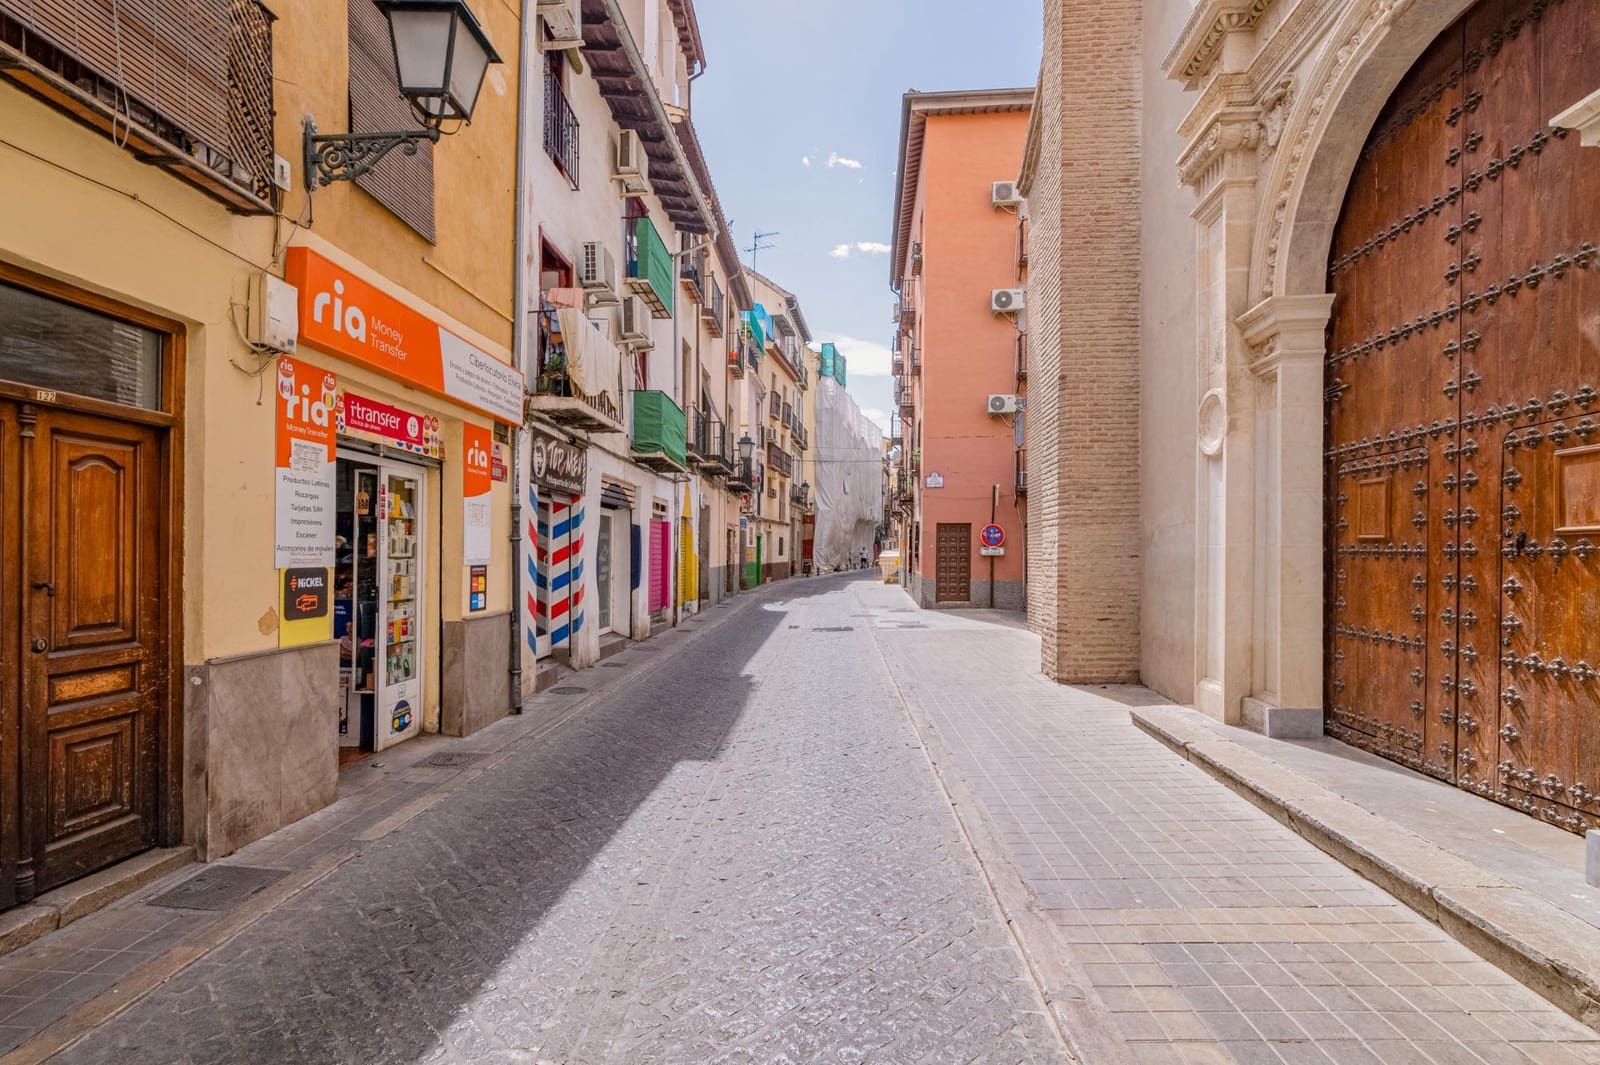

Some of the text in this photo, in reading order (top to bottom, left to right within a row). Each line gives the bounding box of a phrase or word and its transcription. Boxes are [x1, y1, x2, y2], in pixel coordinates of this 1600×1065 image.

[314, 280, 366, 343] ria
[371, 316, 403, 346] Money
[371, 333, 407, 360] Transfer
[39, 391, 55, 401] 122
[286, 384, 329, 427] ria
[286, 423, 307, 435] Money
[467, 440, 488, 468] ria
[282, 475, 330, 489] Productos Latinos
[295, 490, 319, 500] Recargas
[290, 504, 312, 513] Tarjetas
[290, 518, 322, 528] Impresiones
[296, 531, 317, 539] Escáner
[277, 544, 307, 552] Accesorios
[307, 544, 314, 552] de
